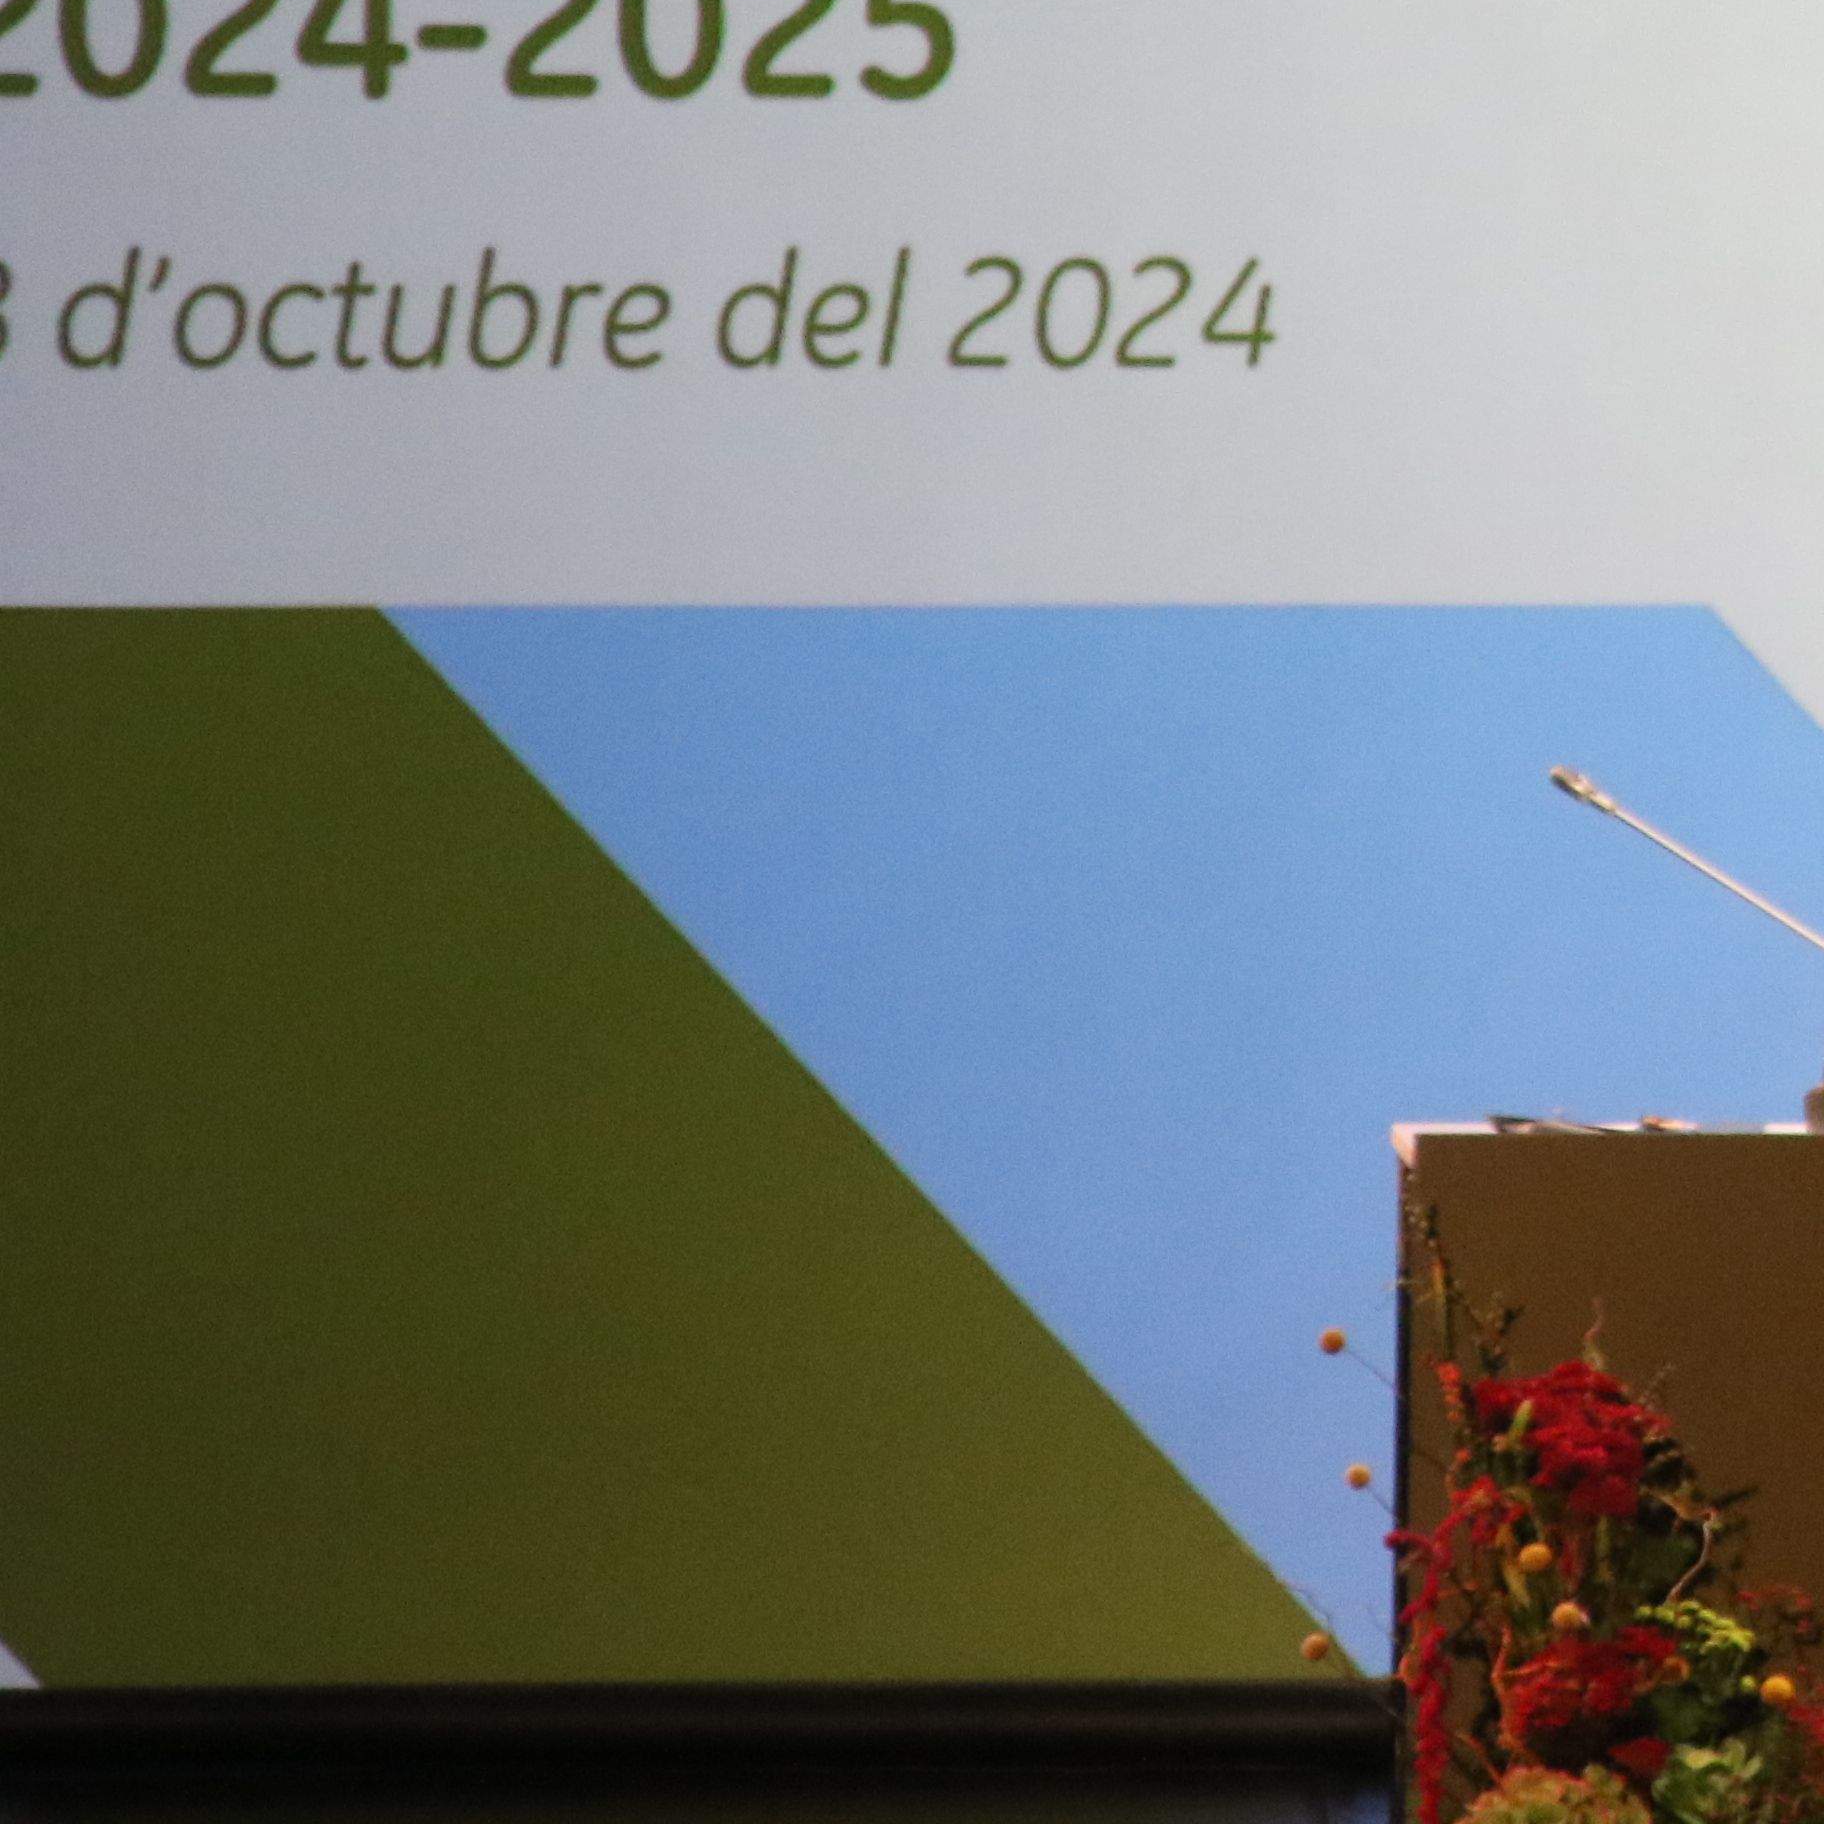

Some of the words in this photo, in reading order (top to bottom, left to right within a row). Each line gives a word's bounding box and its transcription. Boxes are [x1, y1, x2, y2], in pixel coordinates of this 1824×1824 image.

[54, 242, 673, 373] d'octubre
[714, 243, 912, 372] del
[946, 254, 1276, 372] 2024
